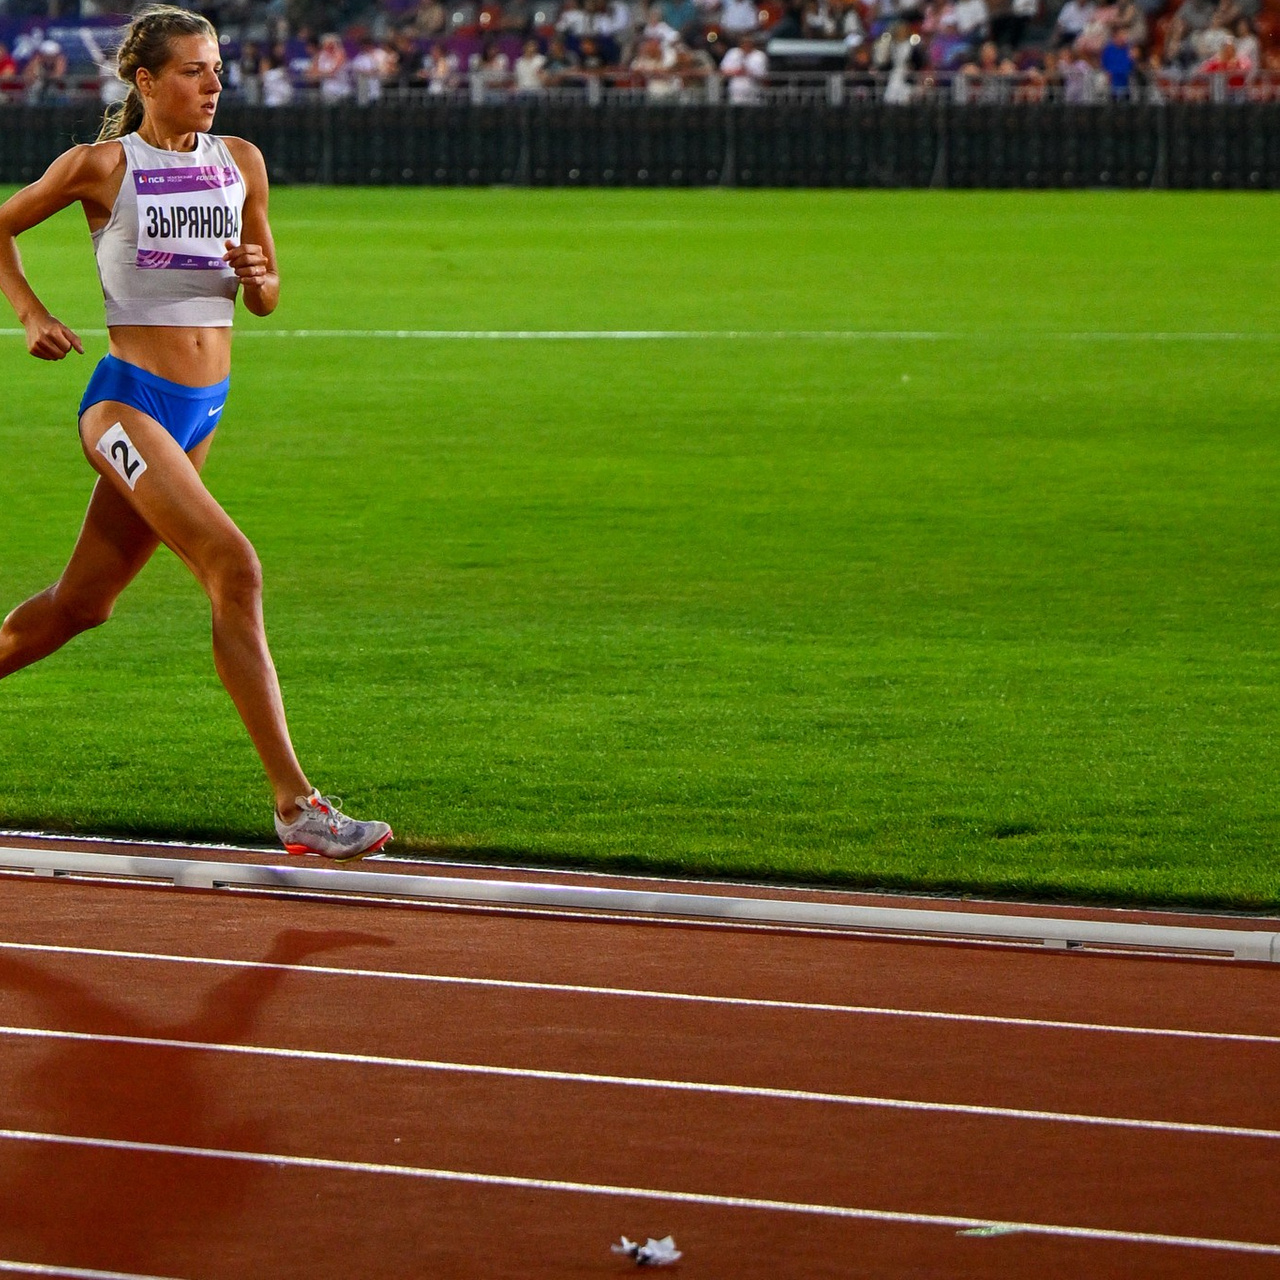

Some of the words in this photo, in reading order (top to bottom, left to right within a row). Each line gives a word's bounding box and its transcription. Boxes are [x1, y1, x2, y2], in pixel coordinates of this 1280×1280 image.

[148, 176, 165, 184] ПСБ
[146, 205, 238, 238] ЗЫРЯНОВА
[111, 440, 140, 480] 2
